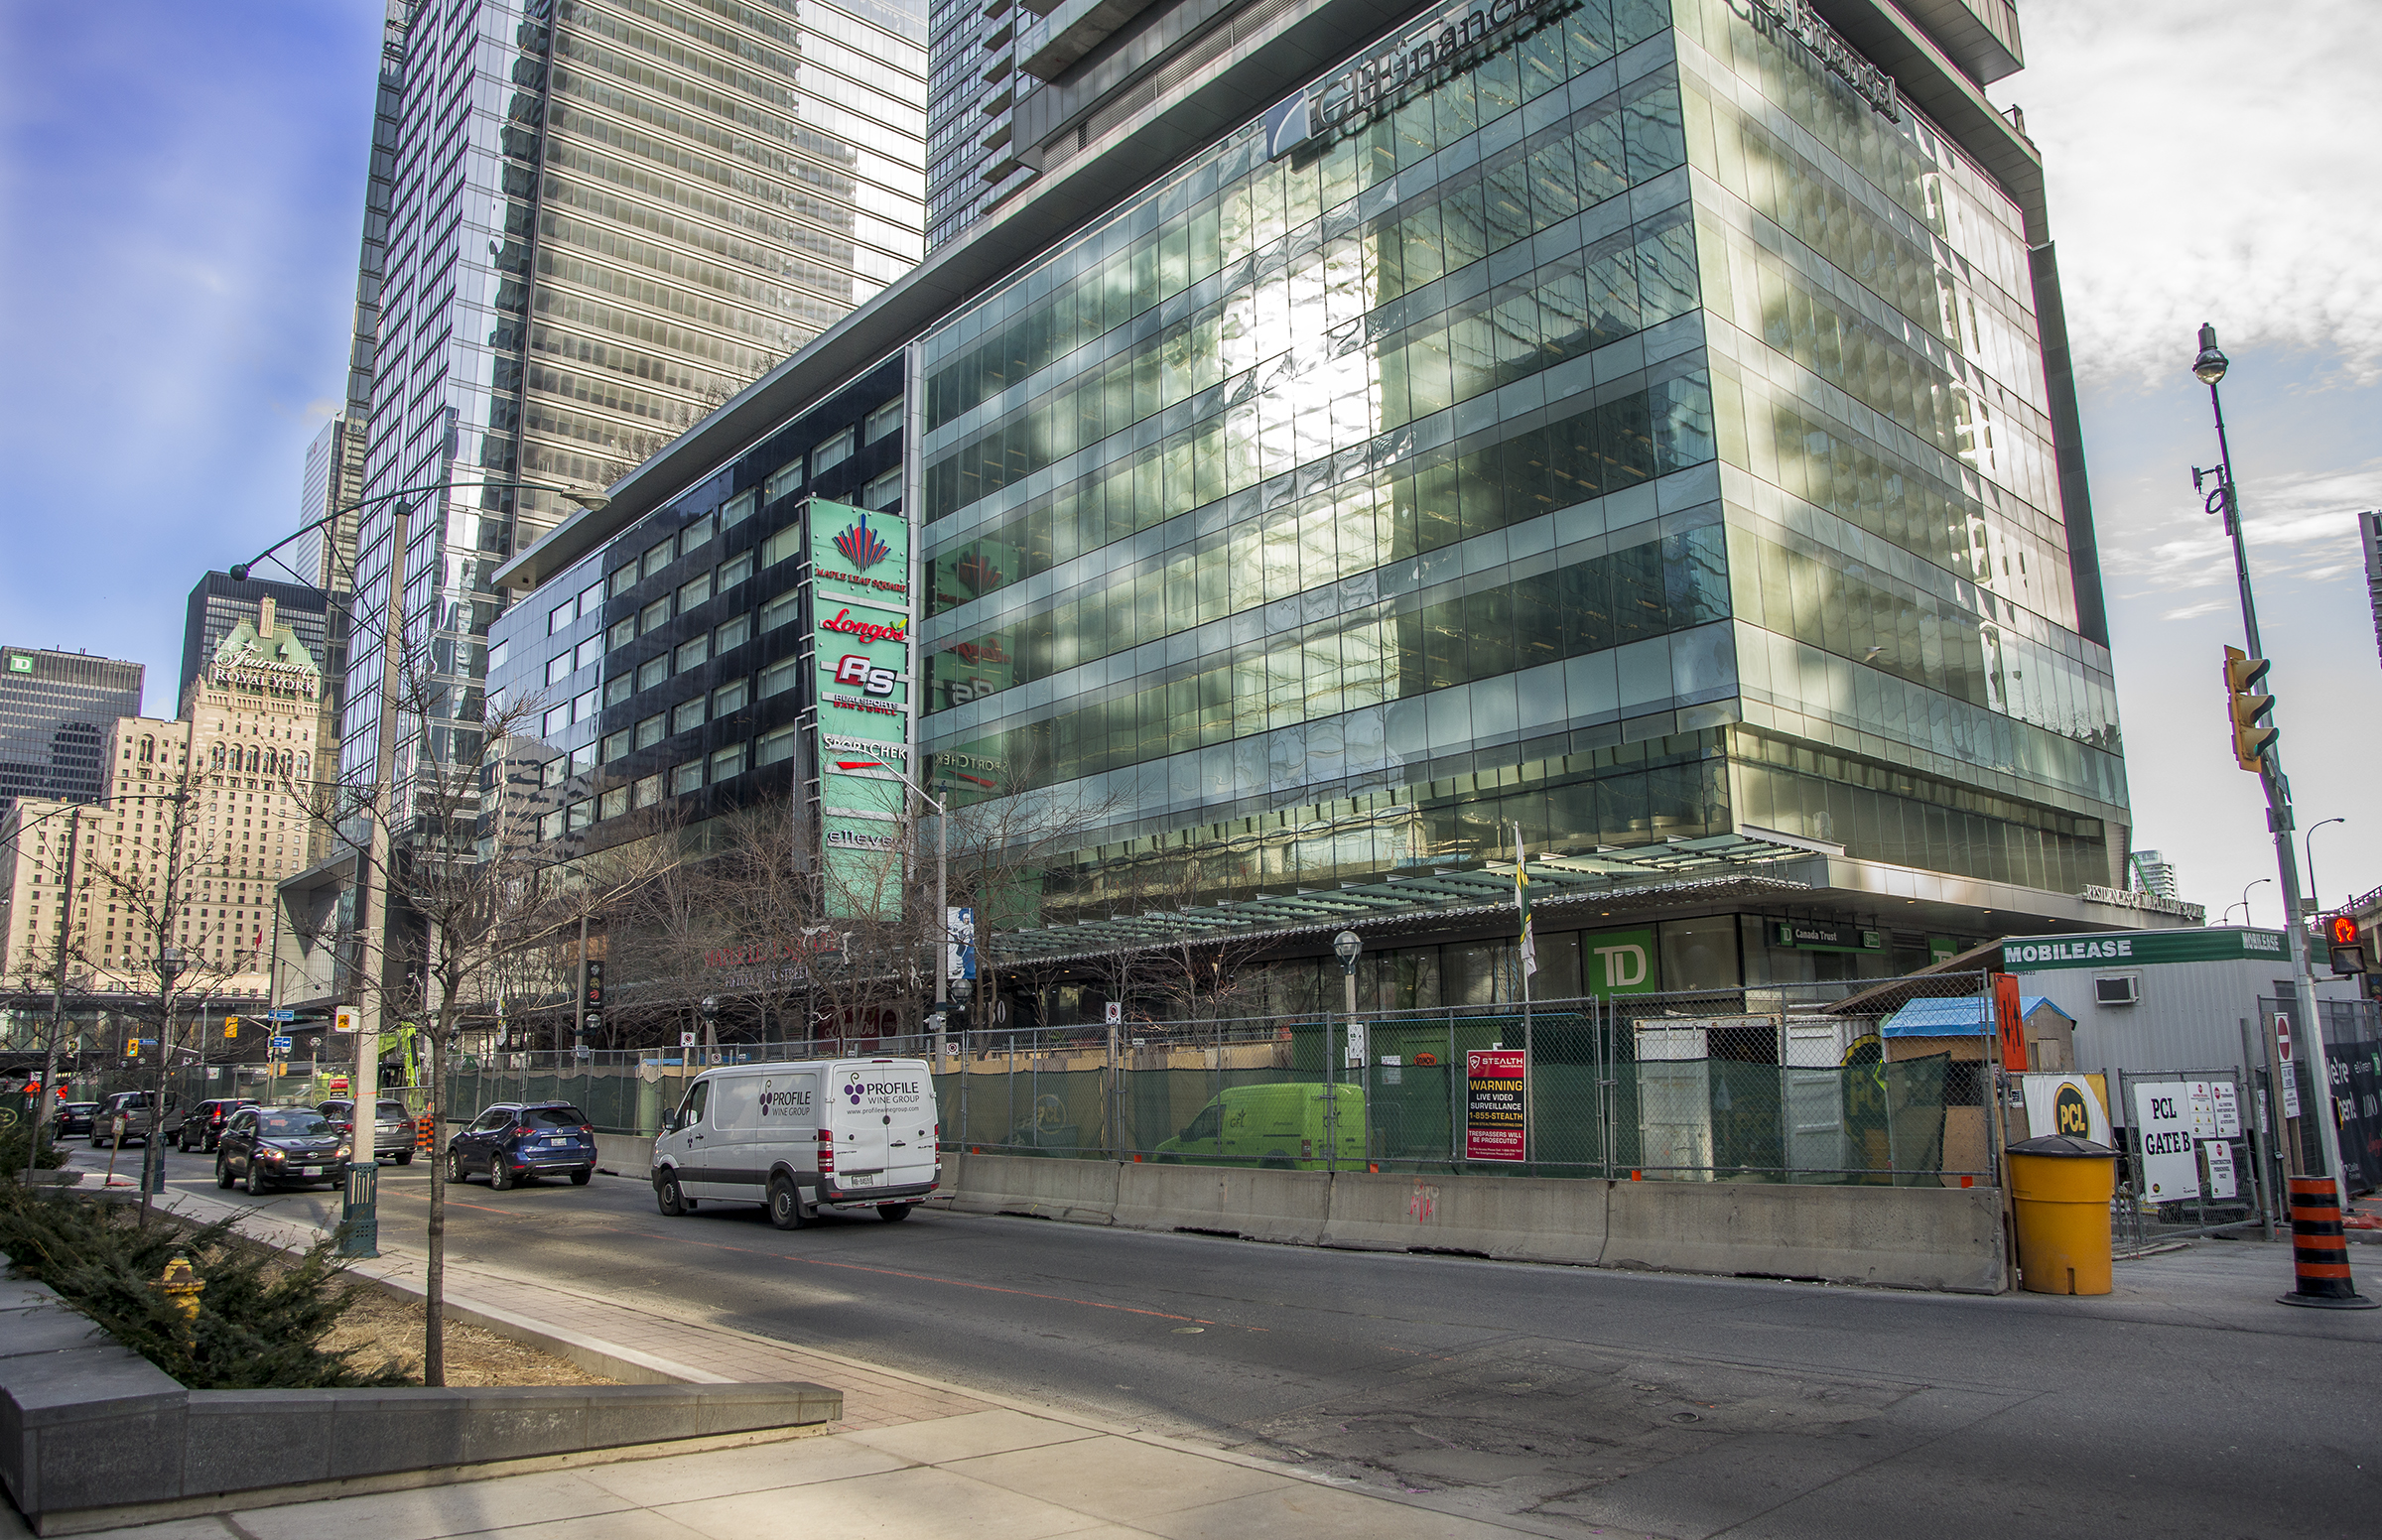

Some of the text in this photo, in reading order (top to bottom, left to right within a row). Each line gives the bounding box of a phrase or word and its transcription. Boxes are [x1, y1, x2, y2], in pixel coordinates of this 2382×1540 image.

[815, 568, 907, 593] MAPLE LEAF SQUARE
[13, 659, 31, 671] TD
[213, 640, 319, 680] Fairmont
[214, 668, 316, 693] ROYAL YORK
[834, 702, 856, 710] BAR
[866, 706, 898, 716] GRILL
[1782, 927, 1837, 942] TD Canada Trust
[2242, 933, 2280, 951] MOBILEASE
[2005, 940, 2132, 962] MOBILEASE
[1593, 944, 1648, 987] TD
[866, 1081, 919, 1095] PROFILE
[1469, 1080, 1523, 1091] WARNING
[772, 1091, 811, 1106] PROFILE
[892, 1094, 920, 1103] GROUP
[772, 1106, 811, 1116] WINE GROUP
[847, 1105, 919, 1115] www.profilewinegroup.com
[1469, 1111, 1523, 1120] 1-855-STEALTH
[2151, 1097, 2178, 1120] PCL
[2059, 1104, 2086, 1132] PCL
[2146, 1131, 2191, 1155] GATE B
